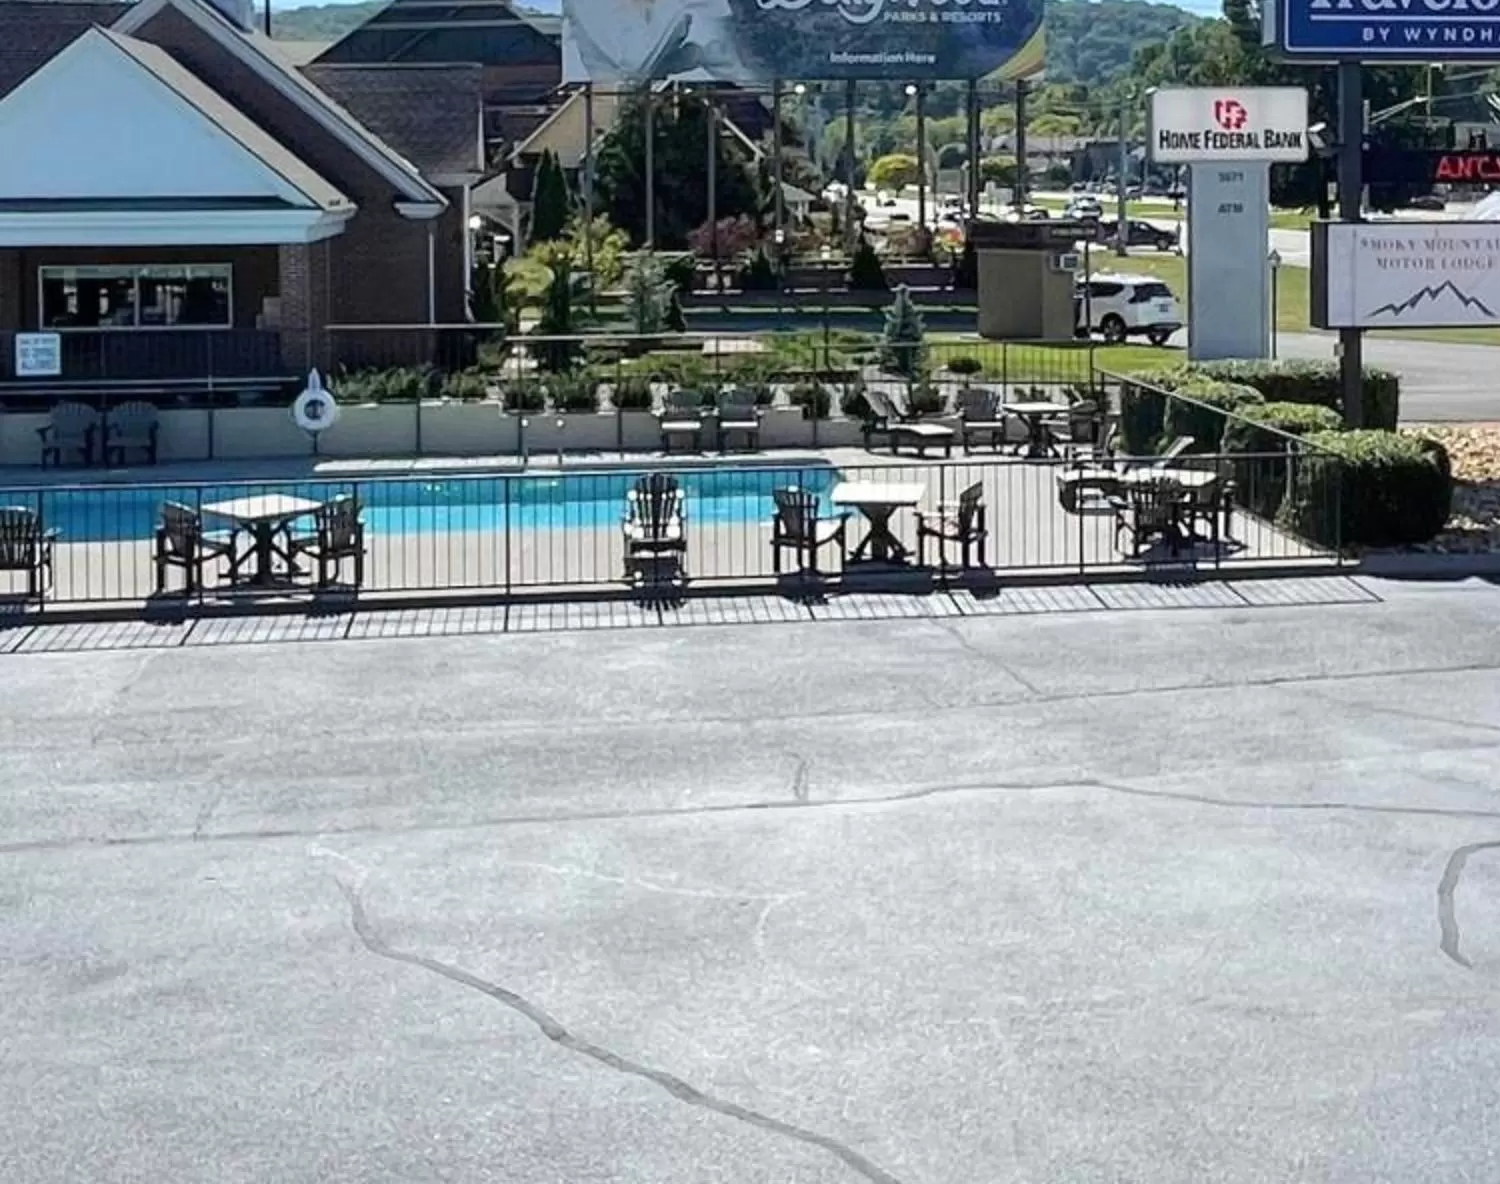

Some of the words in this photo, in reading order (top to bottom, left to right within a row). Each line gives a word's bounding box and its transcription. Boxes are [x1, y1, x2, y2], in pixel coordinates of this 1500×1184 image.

[1363, 28, 1391, 41] BY
[829, 52, 902, 64] Information
[906, 53, 937, 64] Here
[1159, 130, 1200, 149] HOME
[1204, 130, 1260, 149] FEDERAL
[1264, 130, 1303, 149] BANK
[1361, 238, 1415, 251] SMOKY
[1377, 257, 1435, 270] MOTOR
[1441, 257, 1493, 269] LODGE
